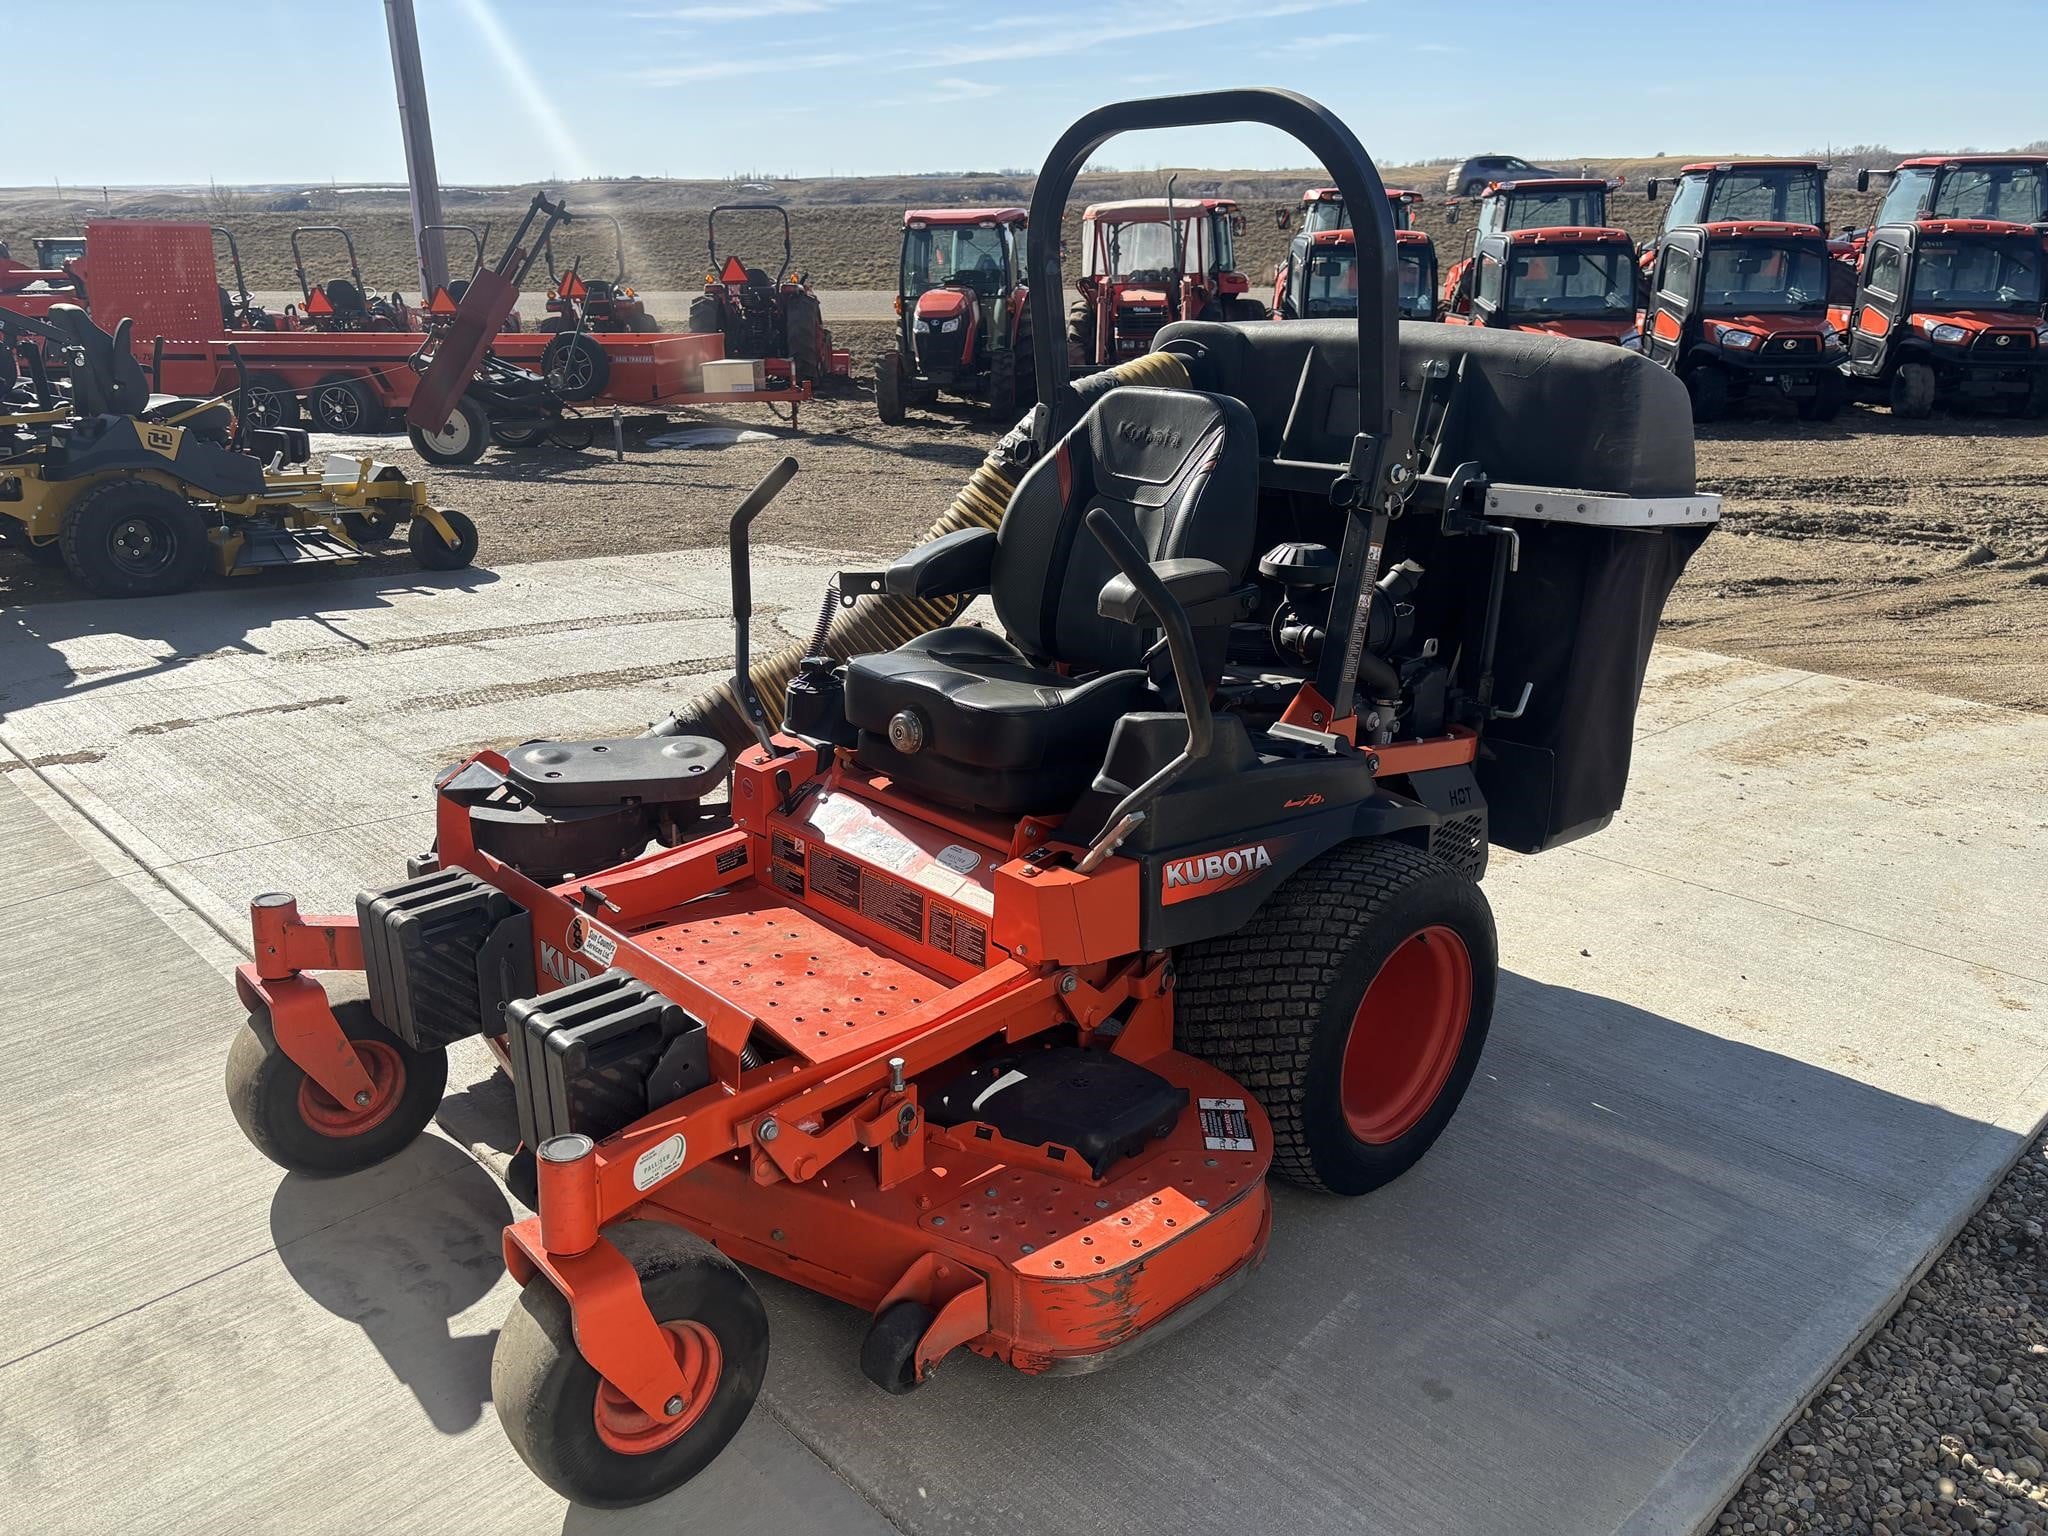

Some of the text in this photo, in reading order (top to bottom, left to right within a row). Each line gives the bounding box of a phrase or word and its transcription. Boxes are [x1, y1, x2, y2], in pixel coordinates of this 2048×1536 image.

[1117, 420, 1181, 448] Kubota
[1449, 785, 1472, 807] HOT
[1166, 845, 1272, 888] KUBOTA
[586, 940, 603, 955] Services
[589, 930, 616, 954] Sun Country
[644, 1154, 670, 1174] PALLISER
